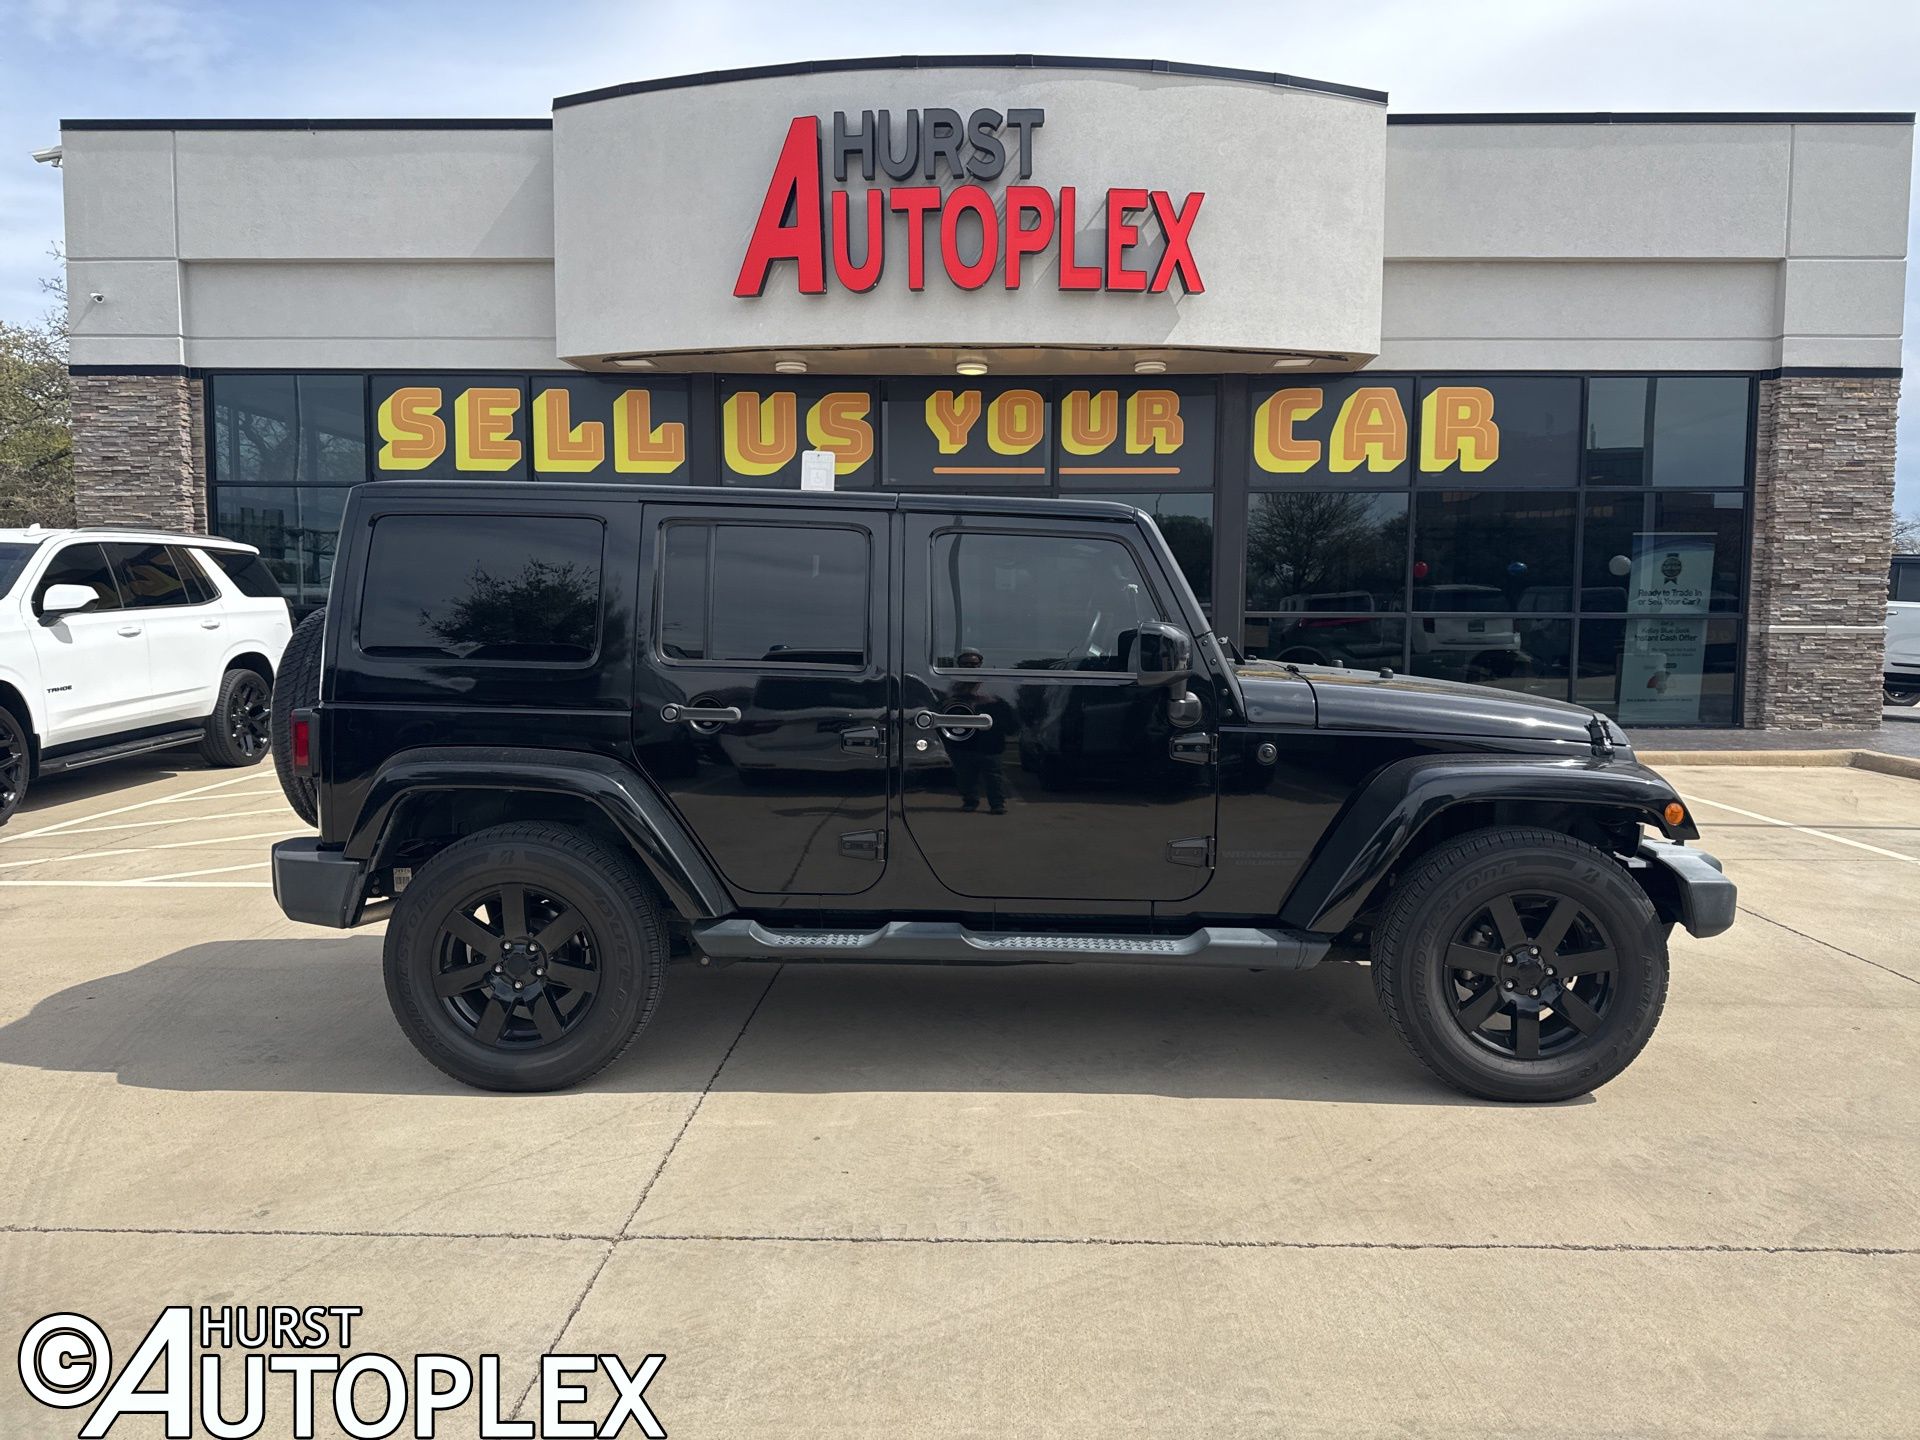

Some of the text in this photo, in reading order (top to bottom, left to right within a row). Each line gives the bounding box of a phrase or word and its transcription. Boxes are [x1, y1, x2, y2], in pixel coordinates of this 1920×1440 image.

[834, 108, 1045, 181] HURST
[733, 115, 1205, 298] AUTOPLEX
[377, 386, 1499, 476] SELL US YOUR CAR
[1638, 589, 1661, 598] Ready
[1672, 588, 1693, 596] Trade
[46, 684, 73, 694] TAHOE
